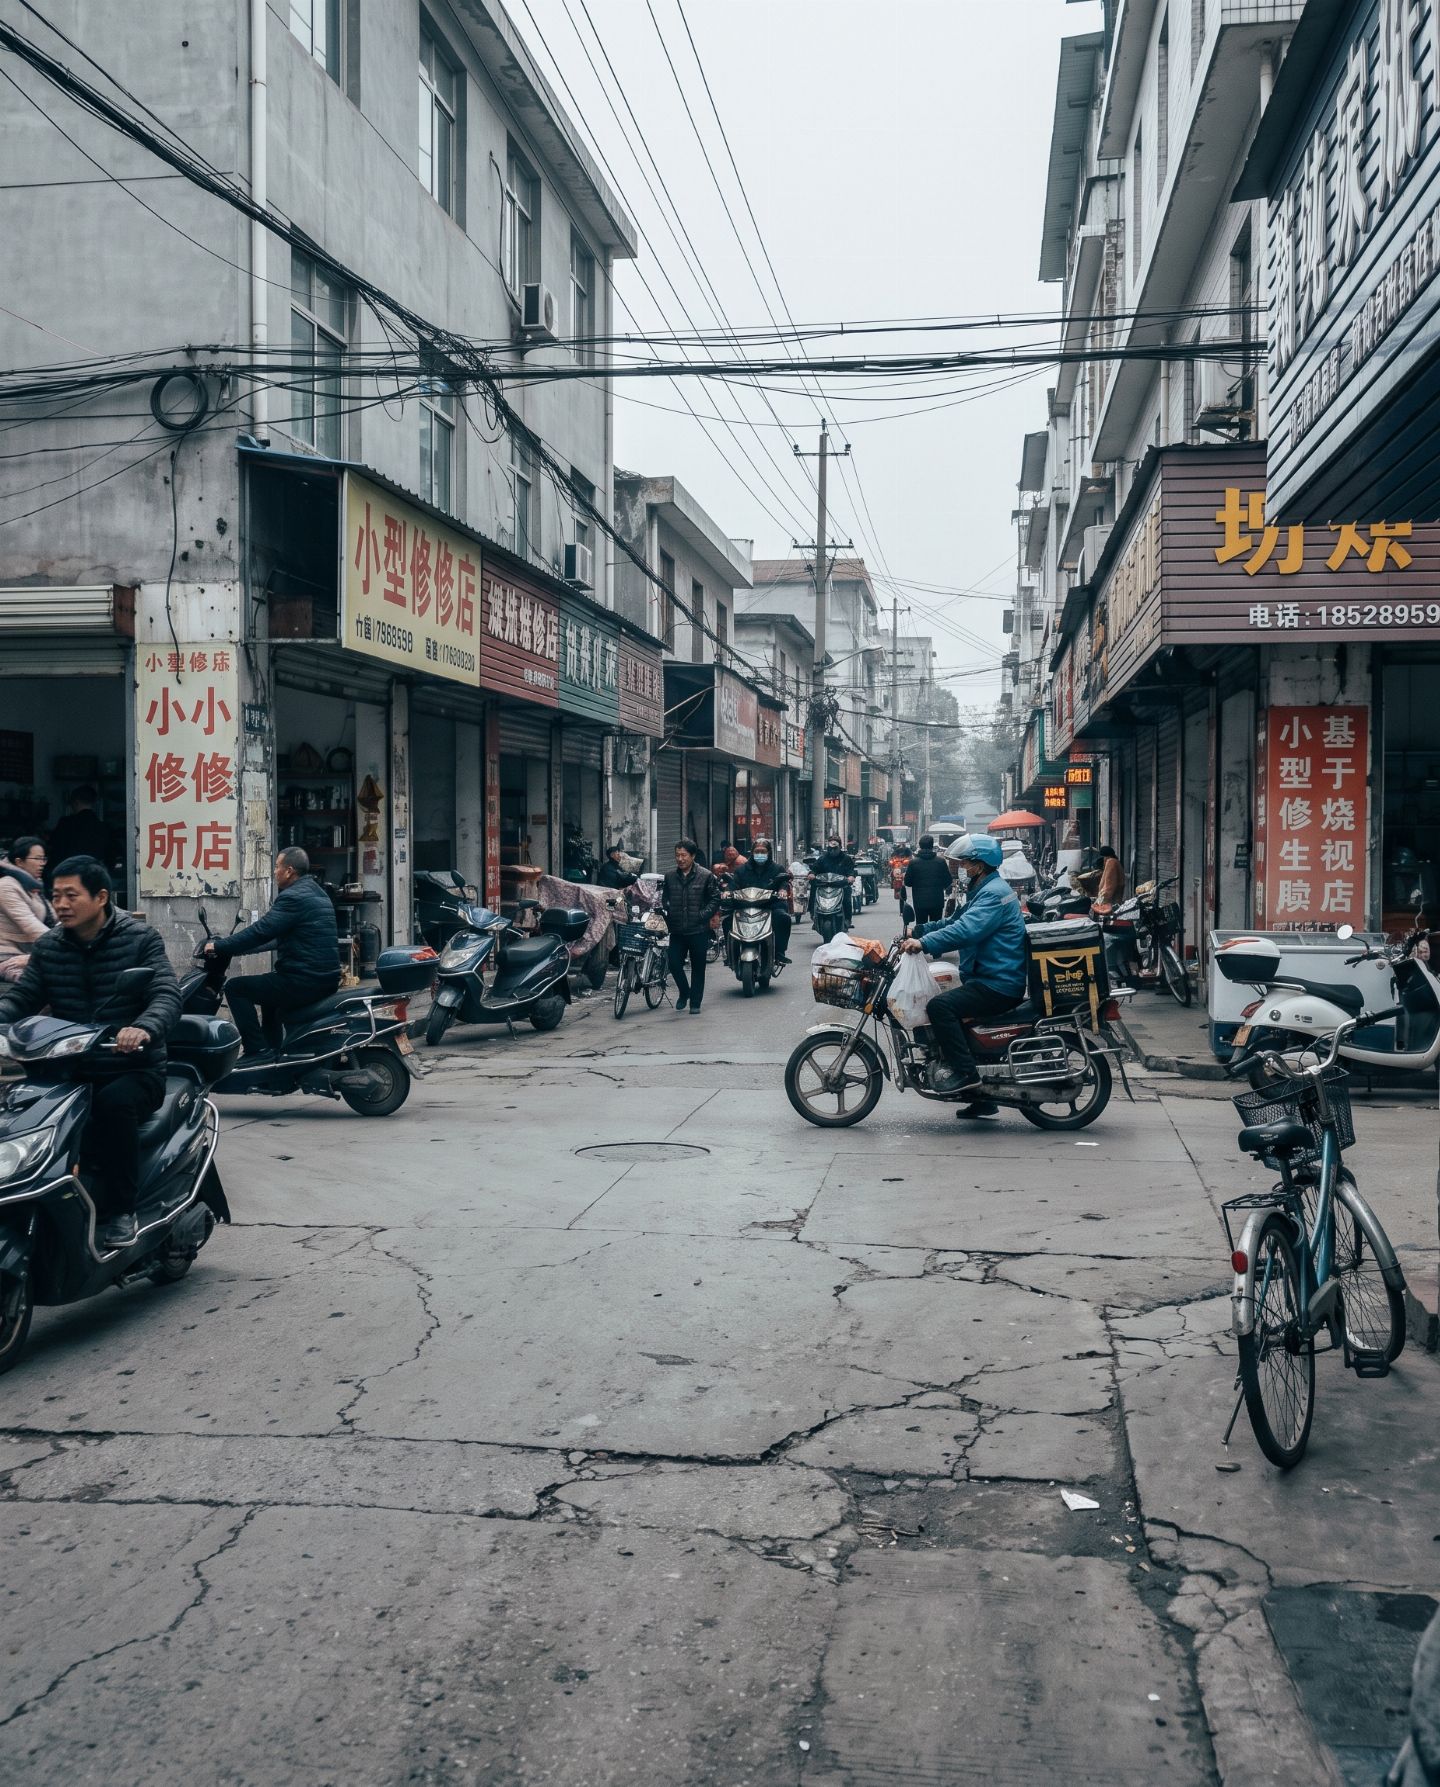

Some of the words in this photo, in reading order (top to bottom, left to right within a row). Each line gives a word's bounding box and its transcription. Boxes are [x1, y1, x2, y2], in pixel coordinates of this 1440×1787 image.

[354, 500, 476, 637] 小型修修店
[1248, 602, 1440, 629] 电话:18528959
[1320, 715, 1356, 913] 基于烧视店
